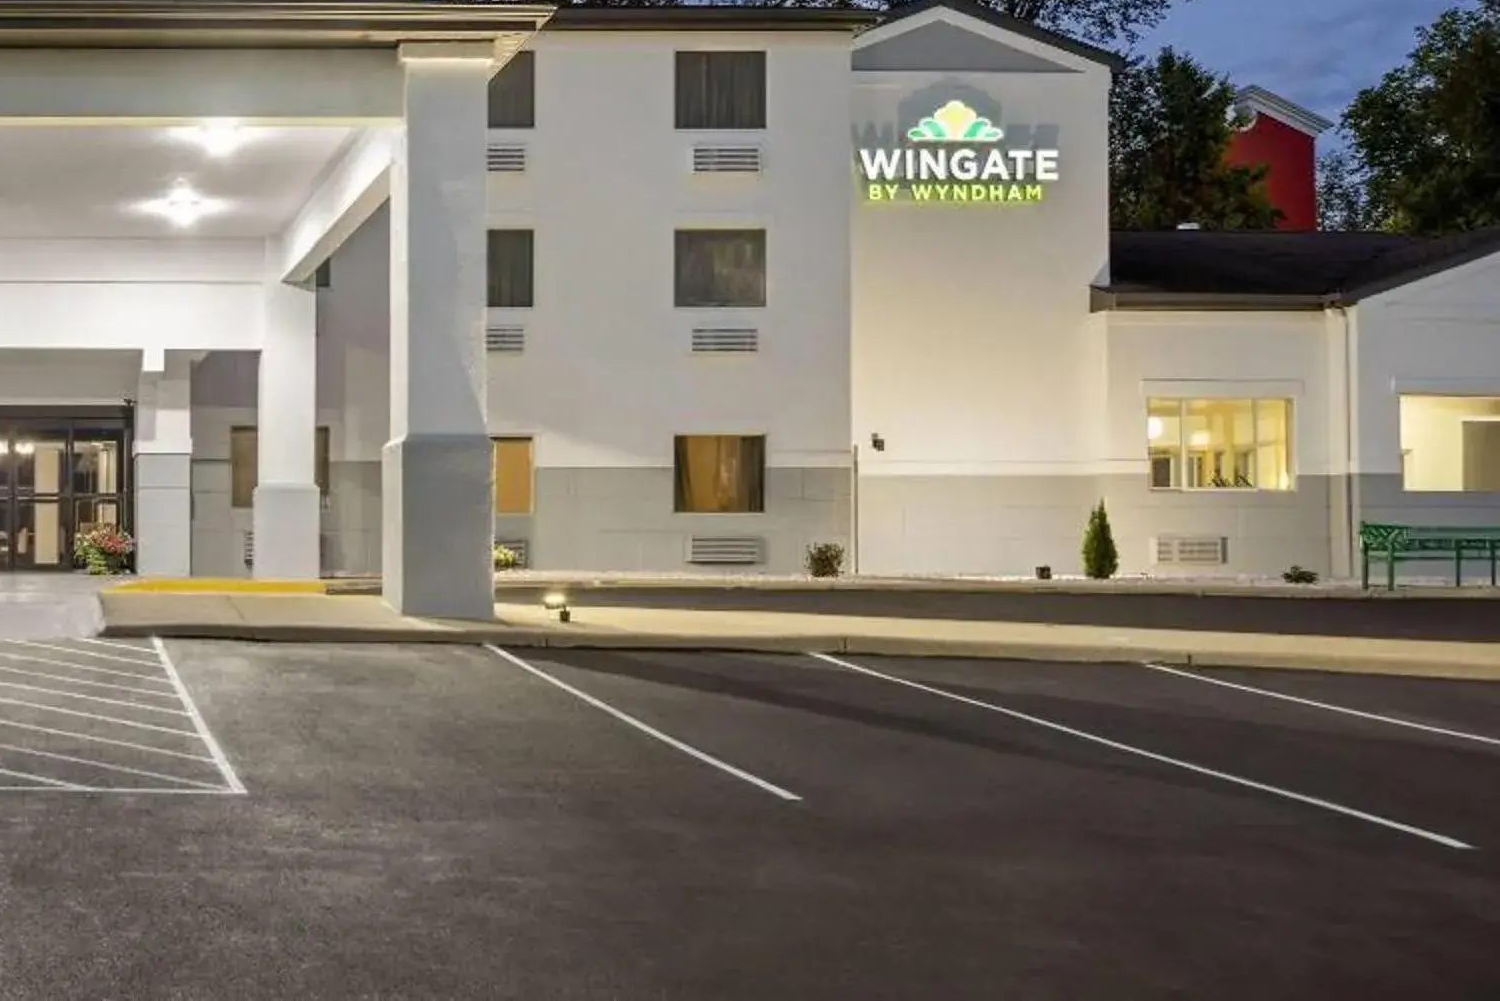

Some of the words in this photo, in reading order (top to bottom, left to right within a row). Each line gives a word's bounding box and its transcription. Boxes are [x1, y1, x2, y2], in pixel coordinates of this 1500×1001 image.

[859, 148, 1059, 181] WINGATE
[868, 184, 899, 200] BY
[911, 184, 1043, 200] WYNDHAM
